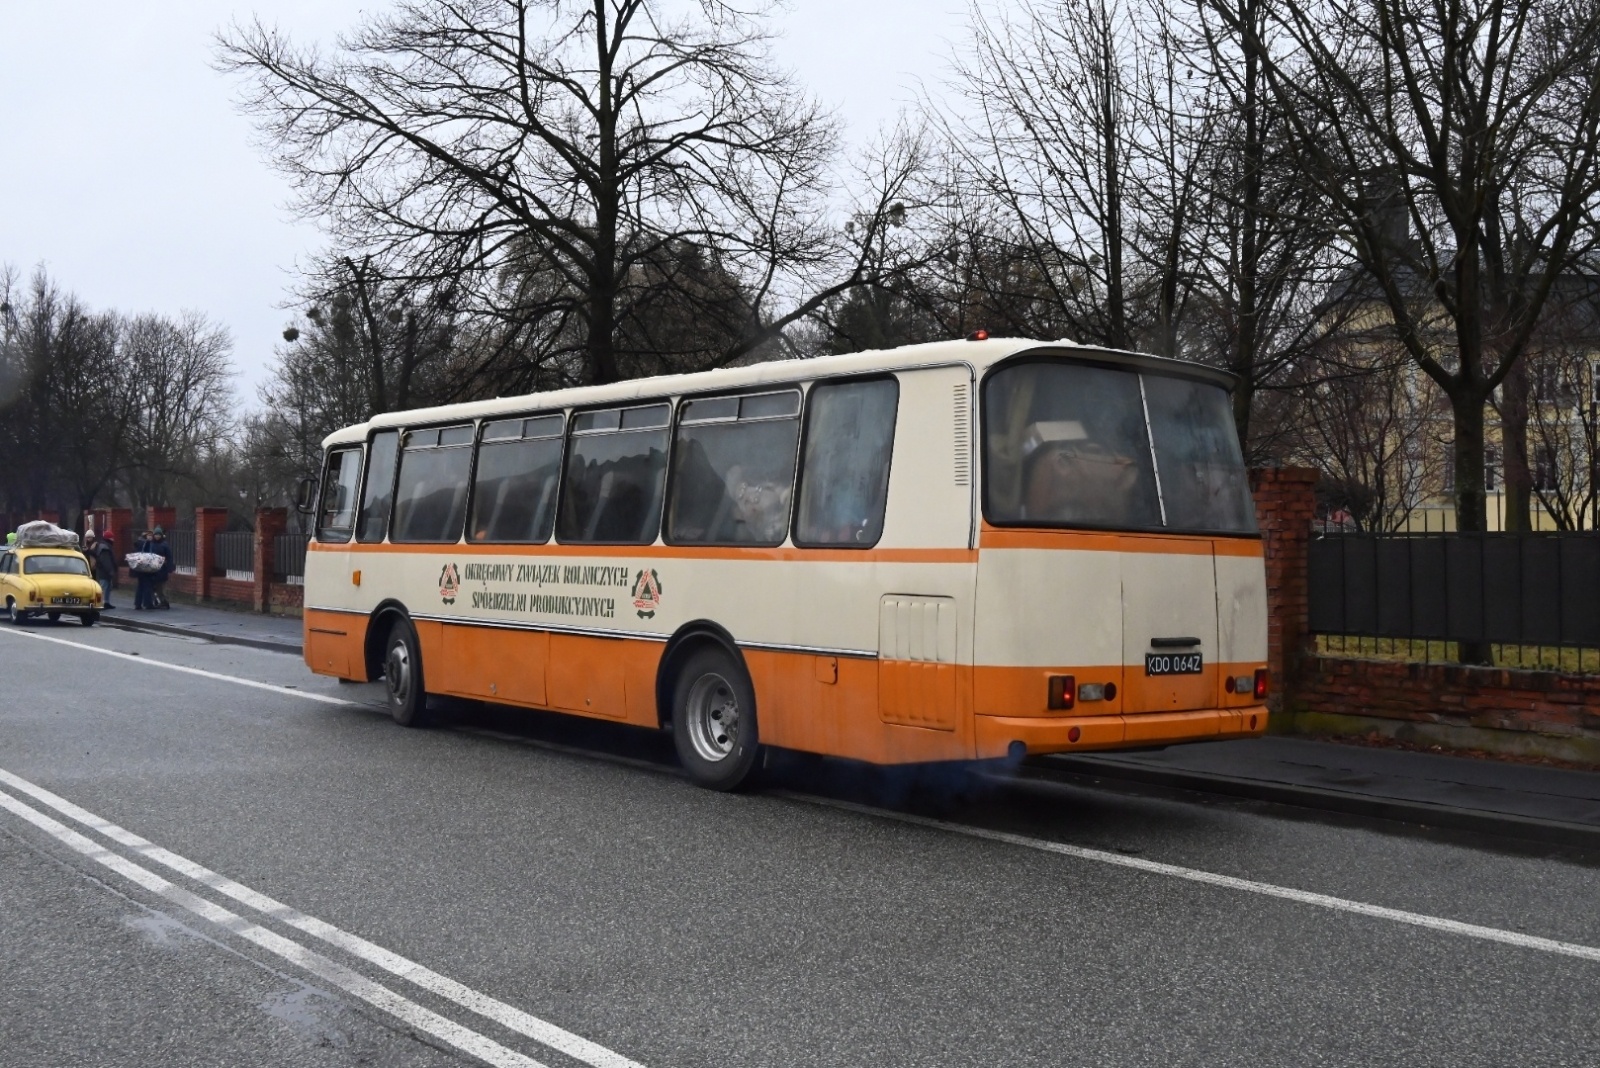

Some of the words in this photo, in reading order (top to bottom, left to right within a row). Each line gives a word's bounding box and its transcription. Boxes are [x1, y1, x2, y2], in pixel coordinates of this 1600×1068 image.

[464, 563, 514, 586] OKRĘGOWY
[516, 564, 561, 588] ZWIĄZEK
[563, 565, 629, 587] ROLNICZYCH
[472, 587, 527, 612] SPÓŁDZIELNI
[529, 594, 615, 618] PRODUKCYJNYCH
[1148, 656, 1170, 672] KDO
[1173, 655, 1201, 671] 064Z
